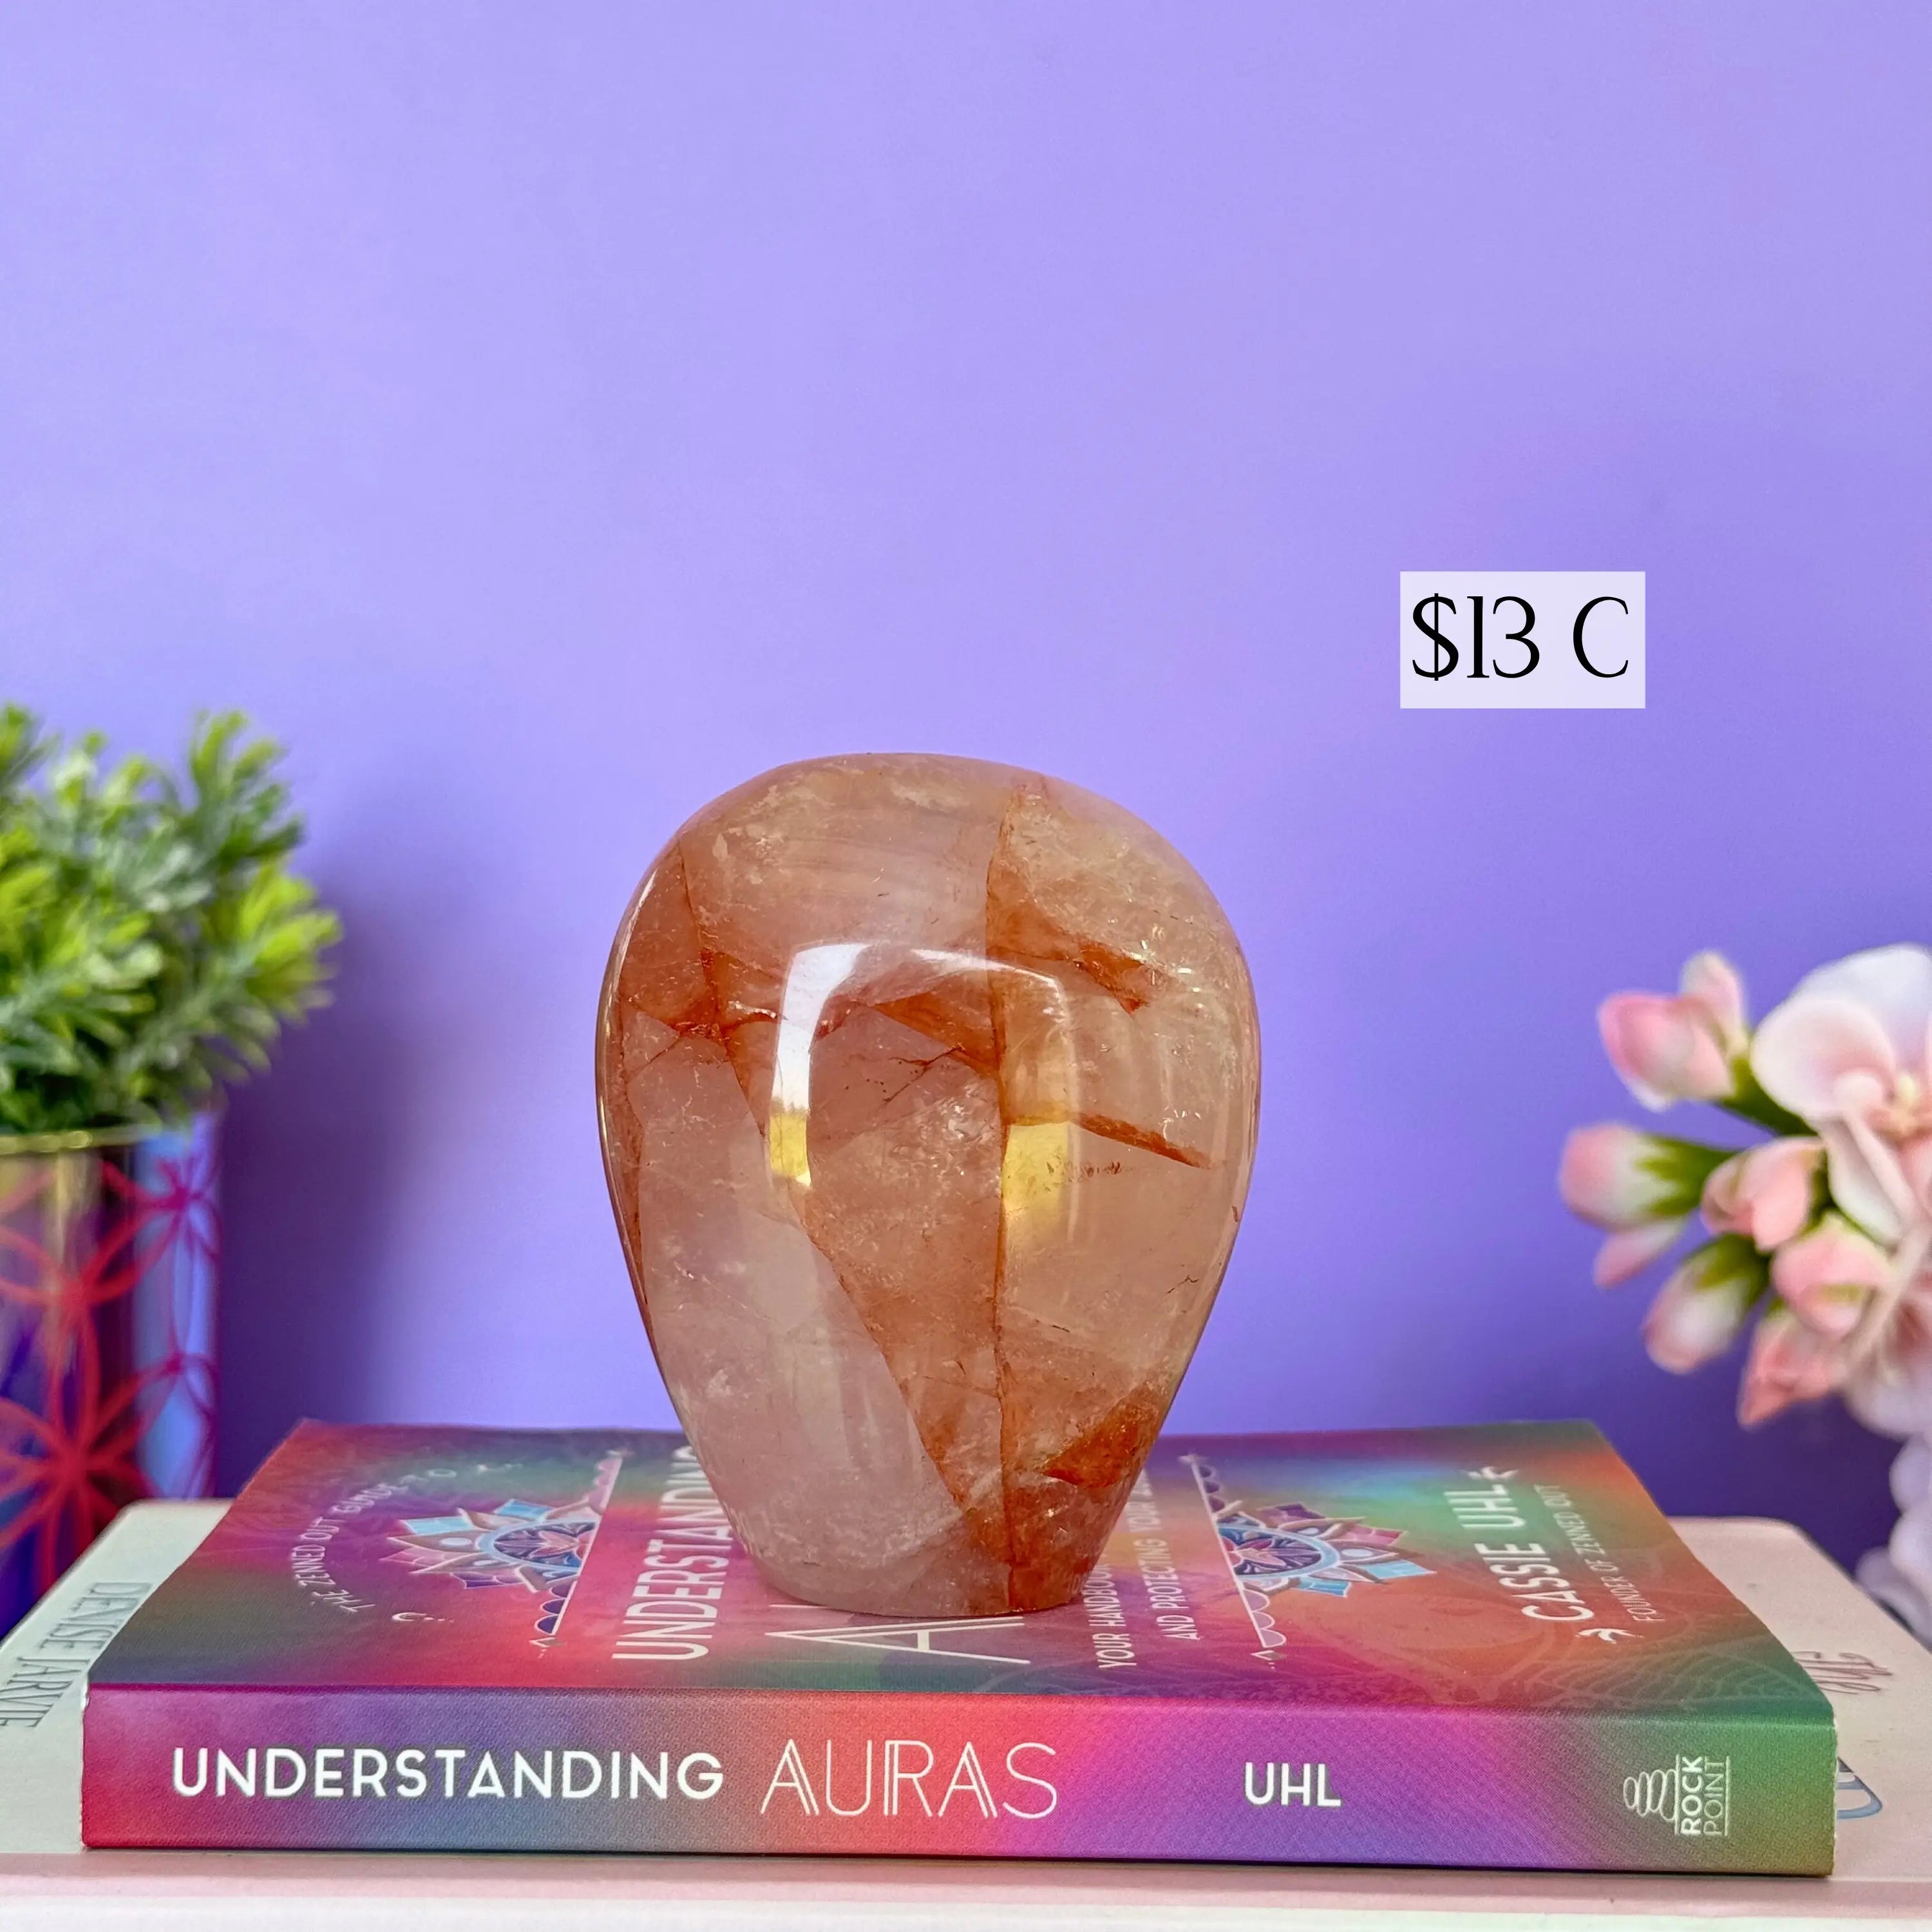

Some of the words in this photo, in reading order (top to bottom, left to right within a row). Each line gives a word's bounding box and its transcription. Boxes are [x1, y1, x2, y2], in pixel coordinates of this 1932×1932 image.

[1443, 1483, 1527, 1528] UHL
[1533, 1484, 1573, 1508] OUT
[299, 1516, 348, 1540] OUT
[1552, 1511, 1607, 1556] ZENNED
[291, 1544, 336, 1587] ZENNED
[1132, 1538, 1189, 1609] PROTECTING
[1473, 1542, 1595, 1621] CASSIE
[1584, 1558, 1620, 1573] OF
[312, 1589, 376, 1613] THE
[1600, 1575, 1666, 1622] FOUNDER
[1156, 1615, 1200, 1640] AND
[1092, 1633, 1137, 1669] YOUR
[173, 1747, 724, 1800] UNDERSTANDING
[761, 1738, 1057, 1819] AURAS
[1245, 1761, 1341, 1807] UHL
[1680, 1756, 1703, 1835] ROCK
[1703, 1756, 1724, 1835] POINT
